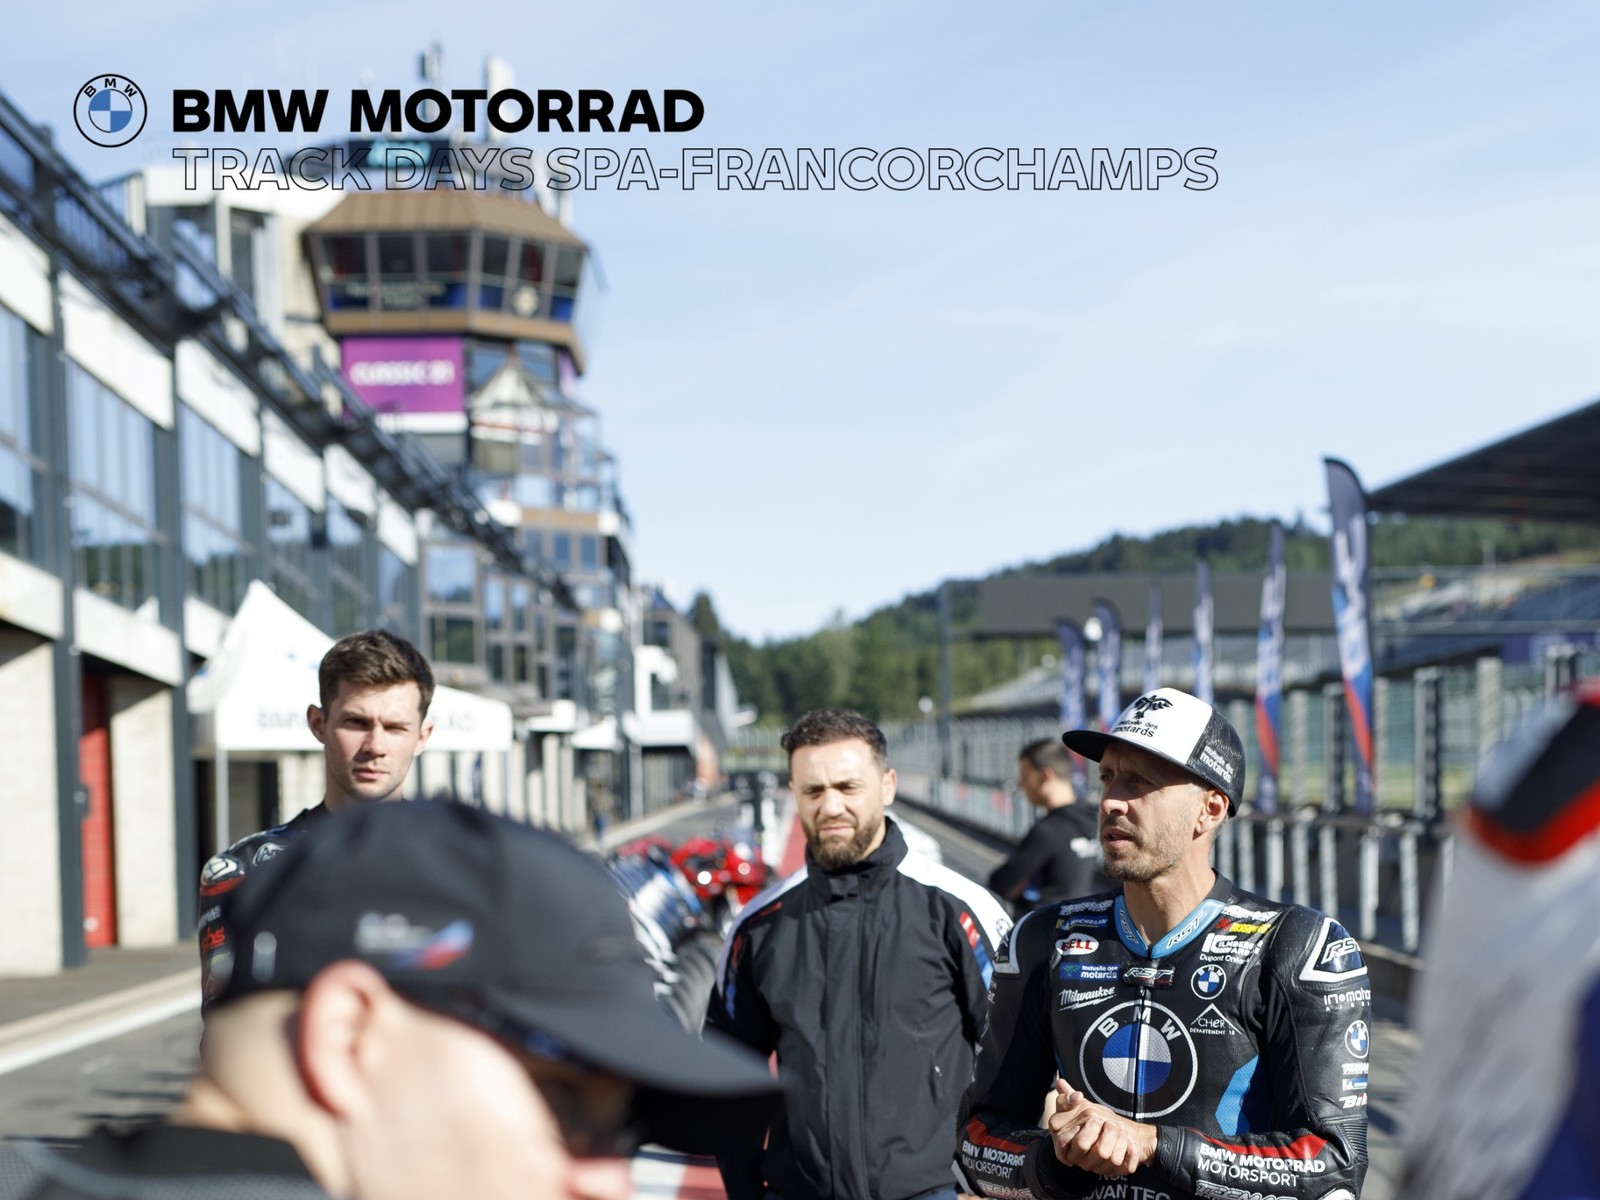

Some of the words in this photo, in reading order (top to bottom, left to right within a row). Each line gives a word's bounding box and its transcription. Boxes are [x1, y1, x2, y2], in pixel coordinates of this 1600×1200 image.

[1166, 909, 1203, 949] RST
[1061, 938, 1093, 951] BELL
[1124, 967, 1175, 979] RST
[1060, 986, 1115, 1005] Milwaukee
[1098, 1006, 1182, 1041] BMW
[1198, 1156, 1299, 1187] MOTORSPORT
[1200, 1143, 1236, 1161] BMW
[1240, 1155, 1326, 1173] MOTORRAD
